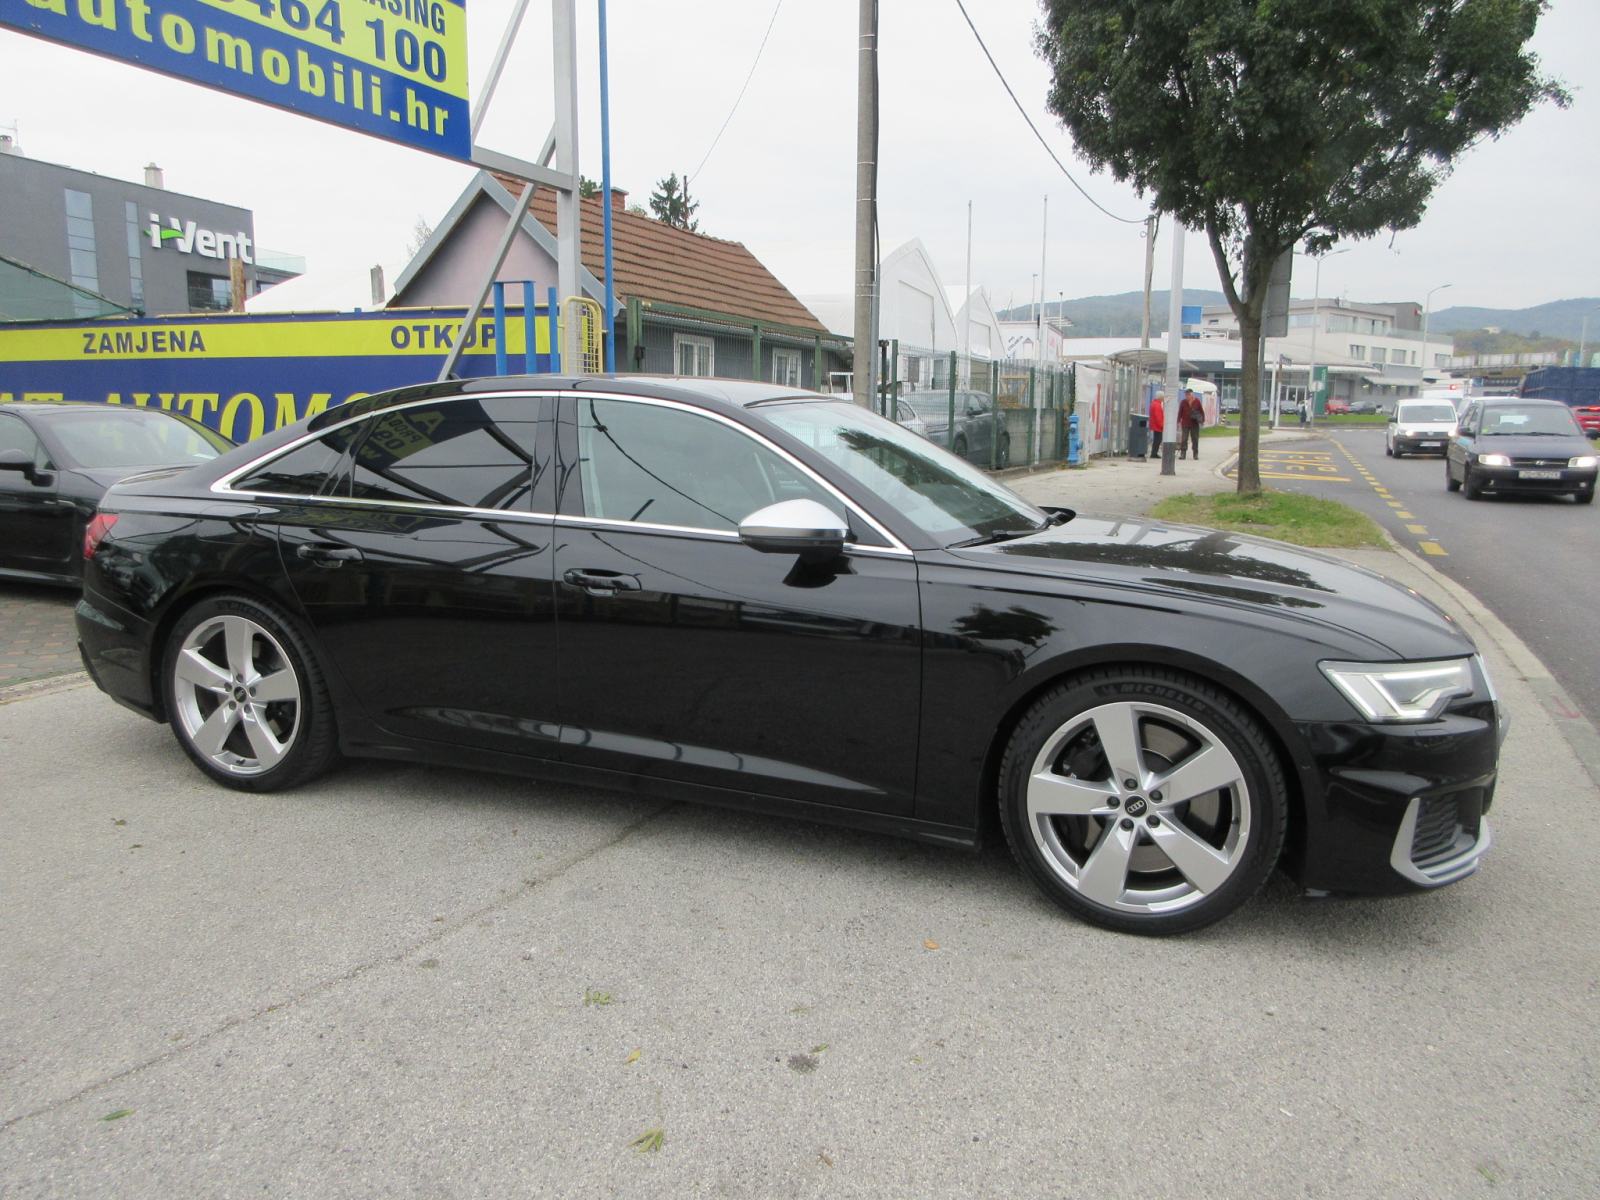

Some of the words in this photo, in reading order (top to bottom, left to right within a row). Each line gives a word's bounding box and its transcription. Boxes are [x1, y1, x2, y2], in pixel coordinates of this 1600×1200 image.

[364, 0, 446, 36] SING
[366, 18, 447, 83] 100
[83, 330, 206, 354] ZAMJENA
[1119, 683, 1207, 712] MICHELIN
